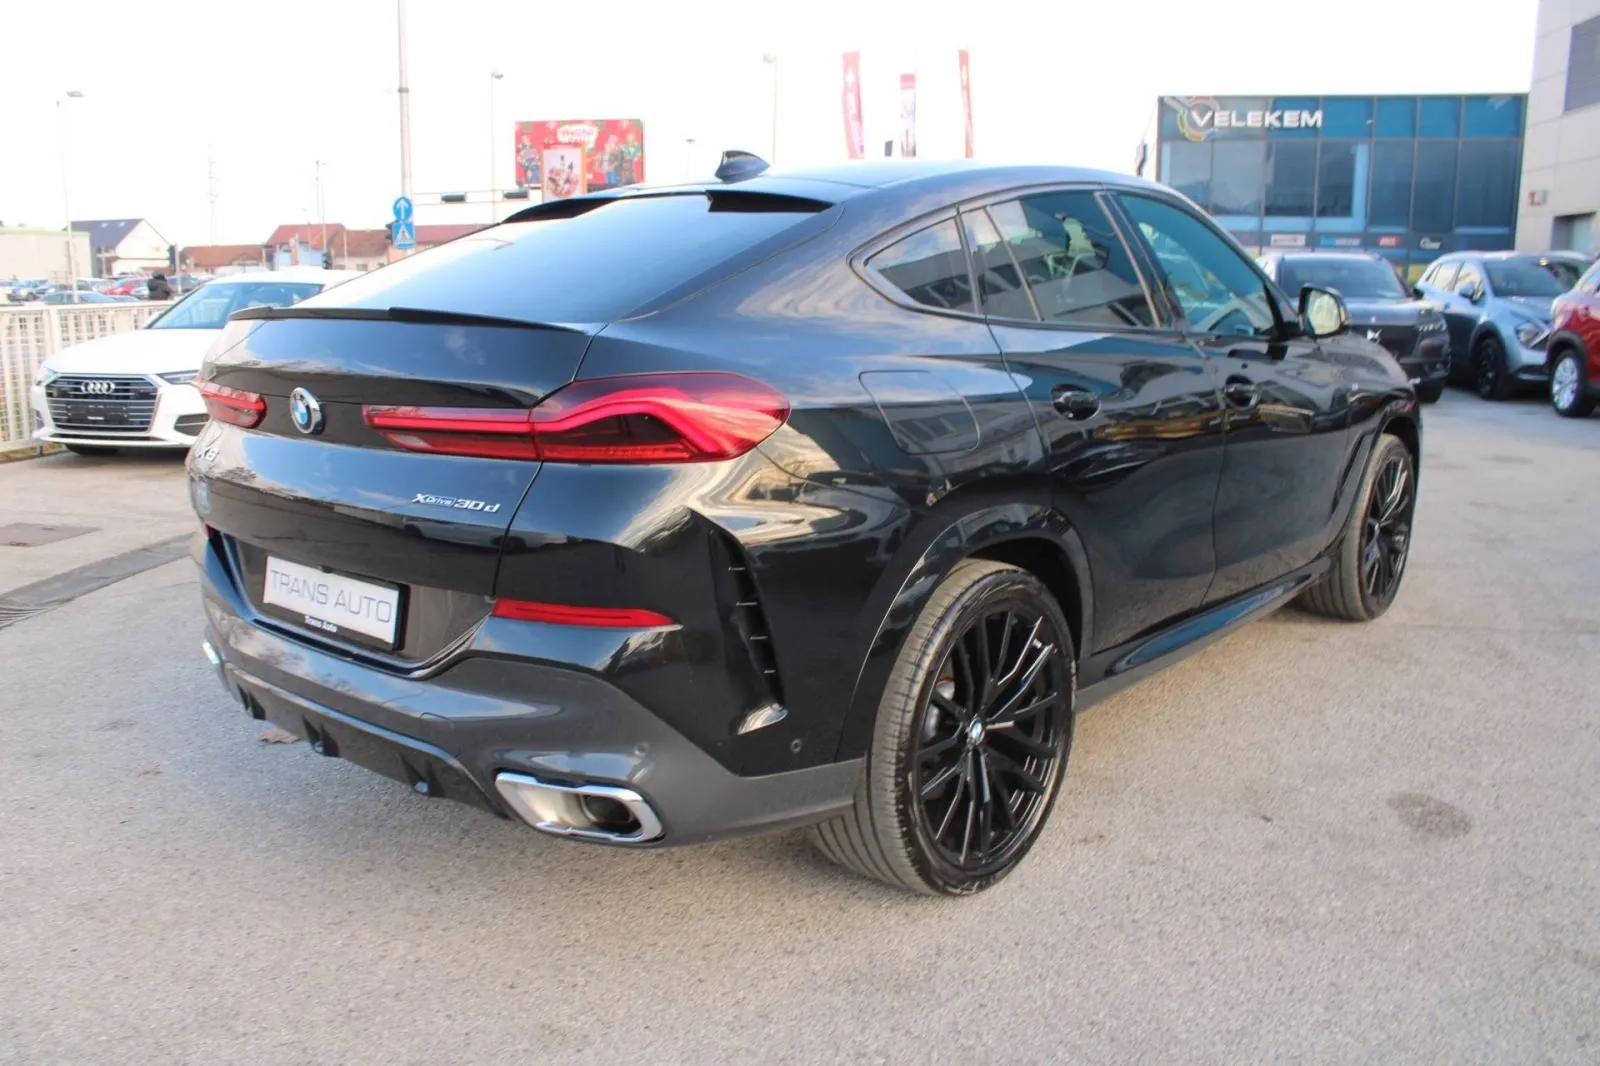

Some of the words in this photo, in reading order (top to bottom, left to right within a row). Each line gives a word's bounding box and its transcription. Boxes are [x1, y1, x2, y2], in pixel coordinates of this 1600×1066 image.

[1190, 109, 1323, 128] VELEKEM
[270, 569, 329, 606] TRANS
[333, 589, 393, 623] AUTO
